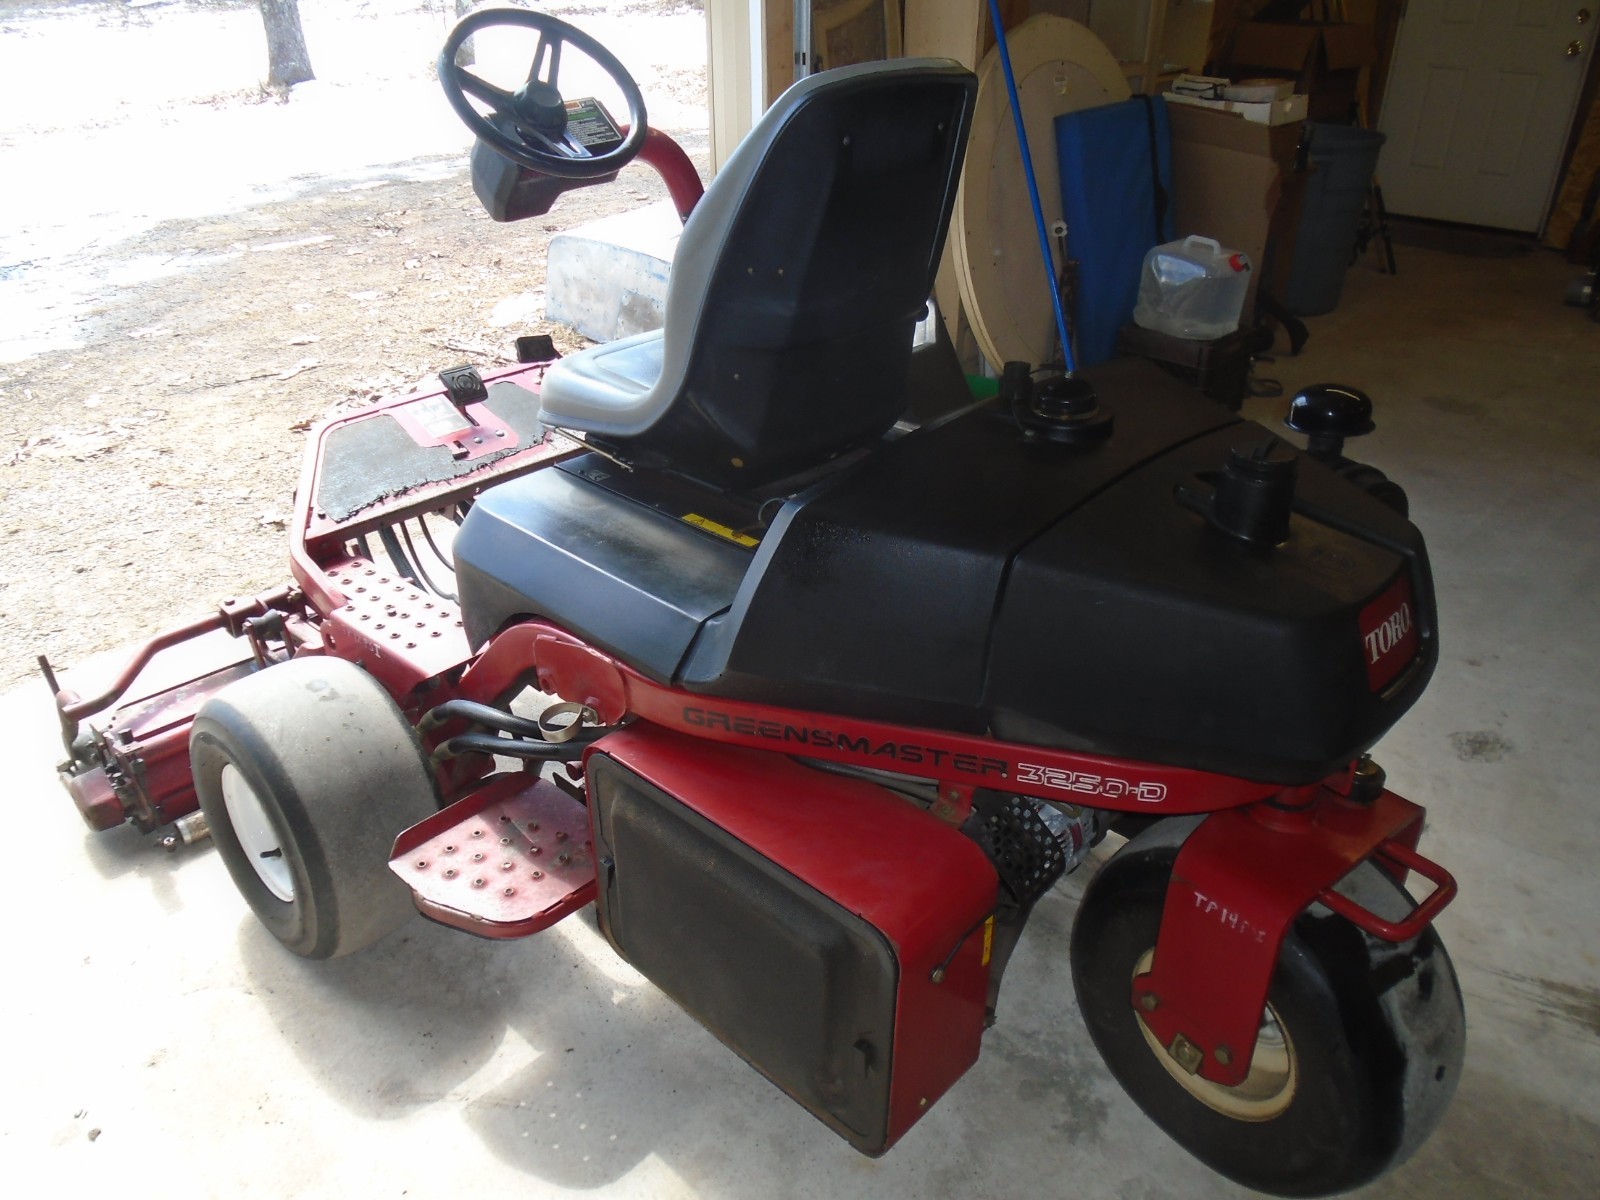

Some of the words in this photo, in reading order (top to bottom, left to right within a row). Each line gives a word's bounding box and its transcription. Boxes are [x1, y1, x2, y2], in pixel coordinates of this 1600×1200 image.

[1364, 602, 1411, 665] TORO
[683, 706, 1008, 776] GREENSMASTER
[1016, 762, 1168, 803] 3250-D
